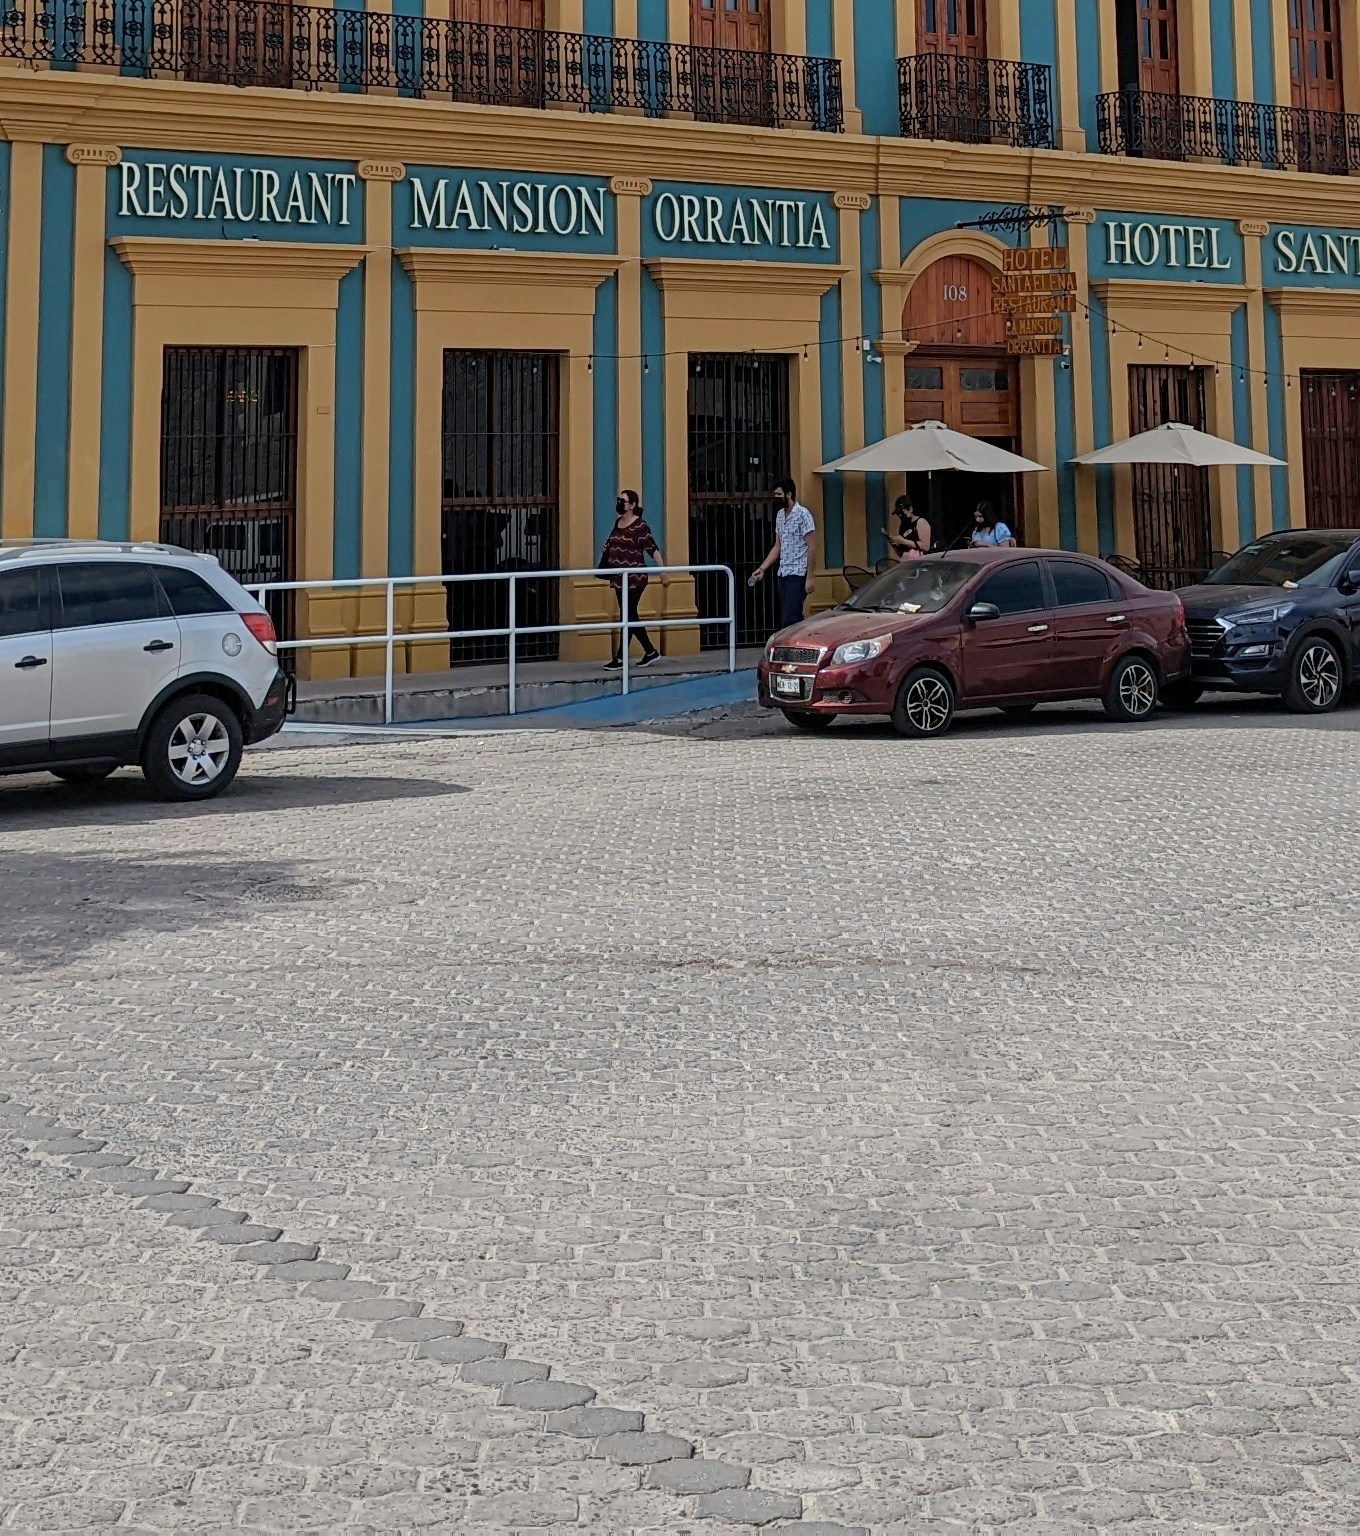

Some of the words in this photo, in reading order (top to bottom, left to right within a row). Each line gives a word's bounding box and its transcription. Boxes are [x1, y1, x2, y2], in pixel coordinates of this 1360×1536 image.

[118, 161, 356, 225] RESTAURANT
[409, 177, 607, 235] MANSION
[655, 192, 831, 248] ORRANTIA
[1105, 221, 1232, 269] HOTEL
[1003, 248, 1066, 270] HOTEL
[943, 284, 968, 302] 108
[992, 295, 1073, 314] RESTAURANT
[1007, 338, 1061, 354] ORRANTIA
